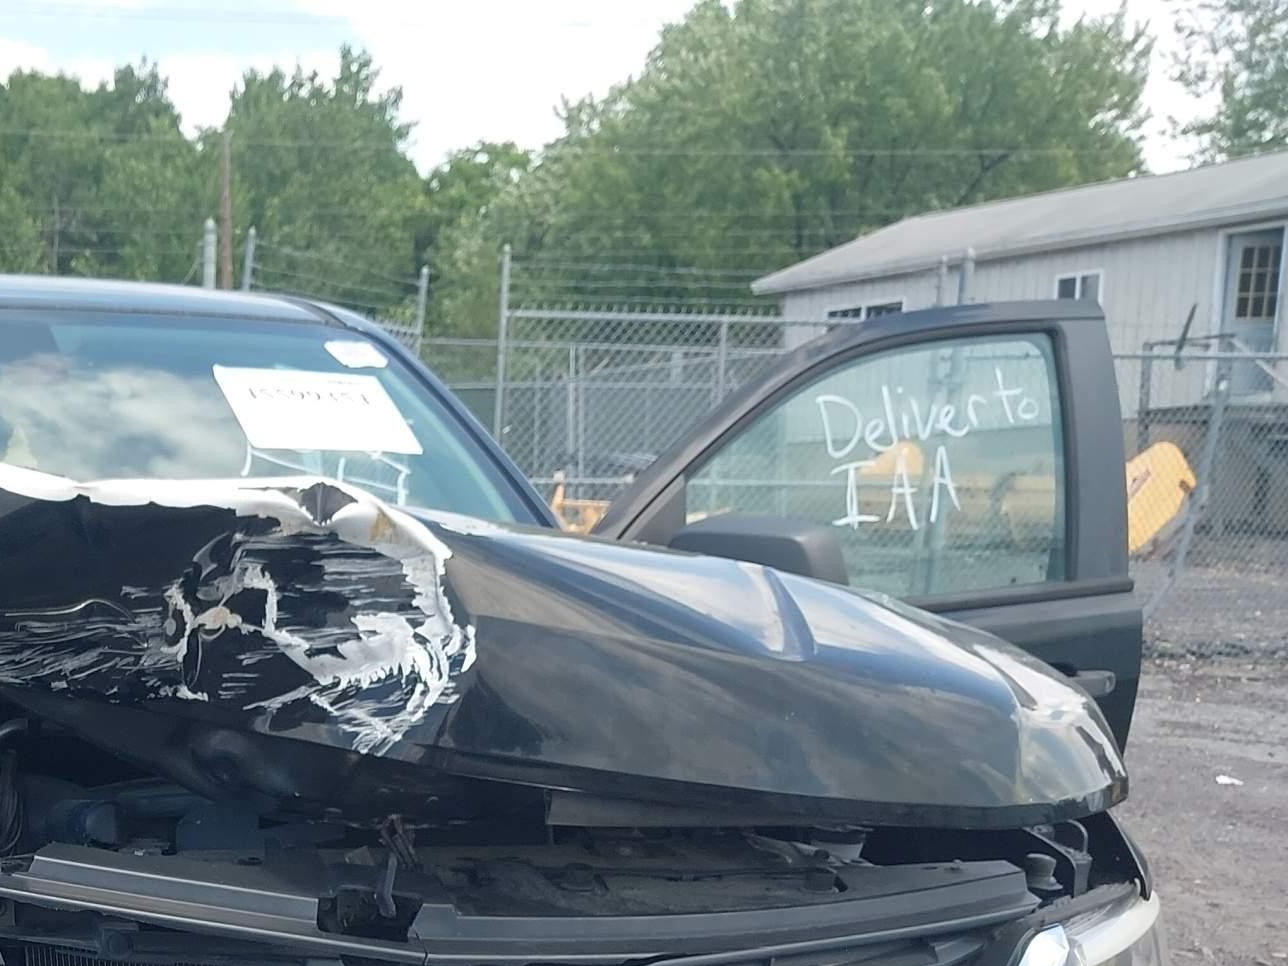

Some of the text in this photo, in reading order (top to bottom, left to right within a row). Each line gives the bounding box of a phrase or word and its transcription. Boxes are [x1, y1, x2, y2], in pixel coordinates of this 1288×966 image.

[815, 366, 1040, 459] Deliver to
[830, 445, 961, 530] IAA
